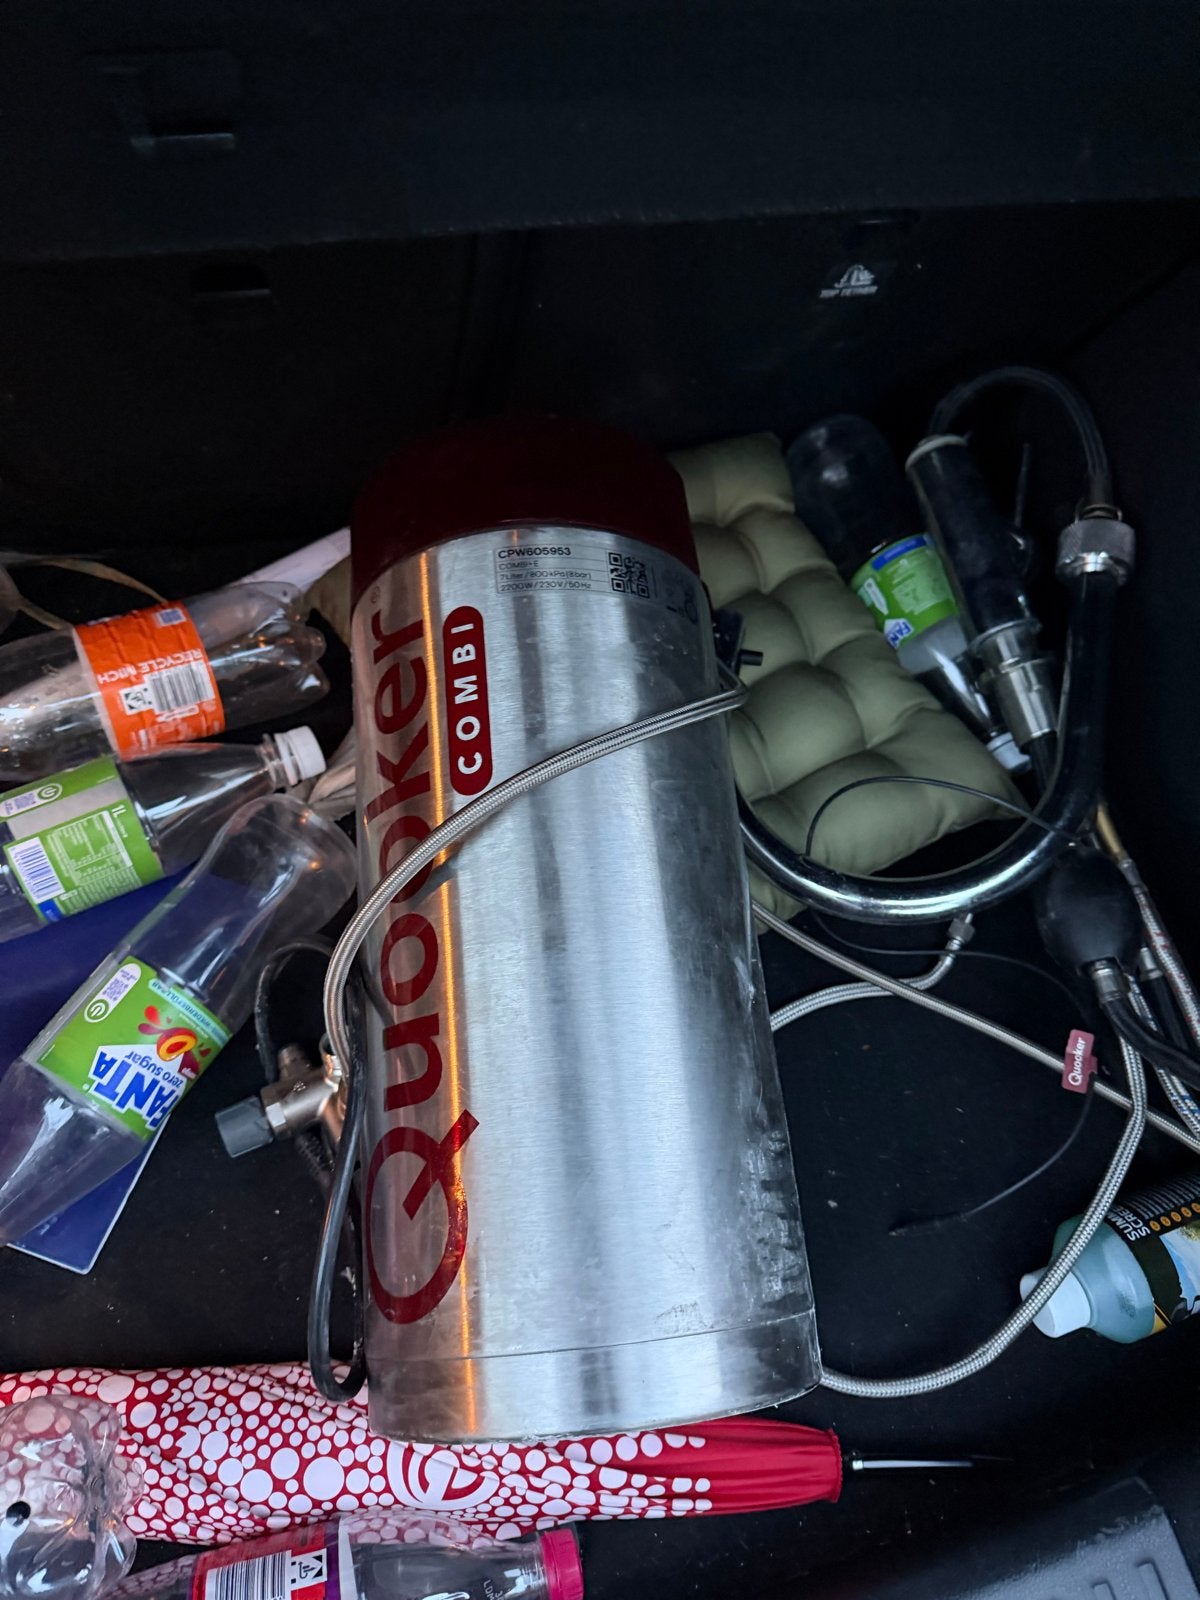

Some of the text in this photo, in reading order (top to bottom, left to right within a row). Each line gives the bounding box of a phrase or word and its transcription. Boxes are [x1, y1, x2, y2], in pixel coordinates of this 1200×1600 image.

[498, 546, 572, 559] CPW605953
[887, 620, 911, 648] FAN
[142, 647, 204, 669] RECYCLE
[450, 622, 483, 775] COMBI
[366, 609, 480, 1325] Quooker
[124, 1050, 163, 1078] sugar
[1068, 1036, 1086, 1086] Quooker
[93, 1050, 181, 1129] FANTA
[162, 1070, 184, 1089] zero
[1106, 1211, 1141, 1242] SUMM
[1116, 1204, 1151, 1237] SCREE
